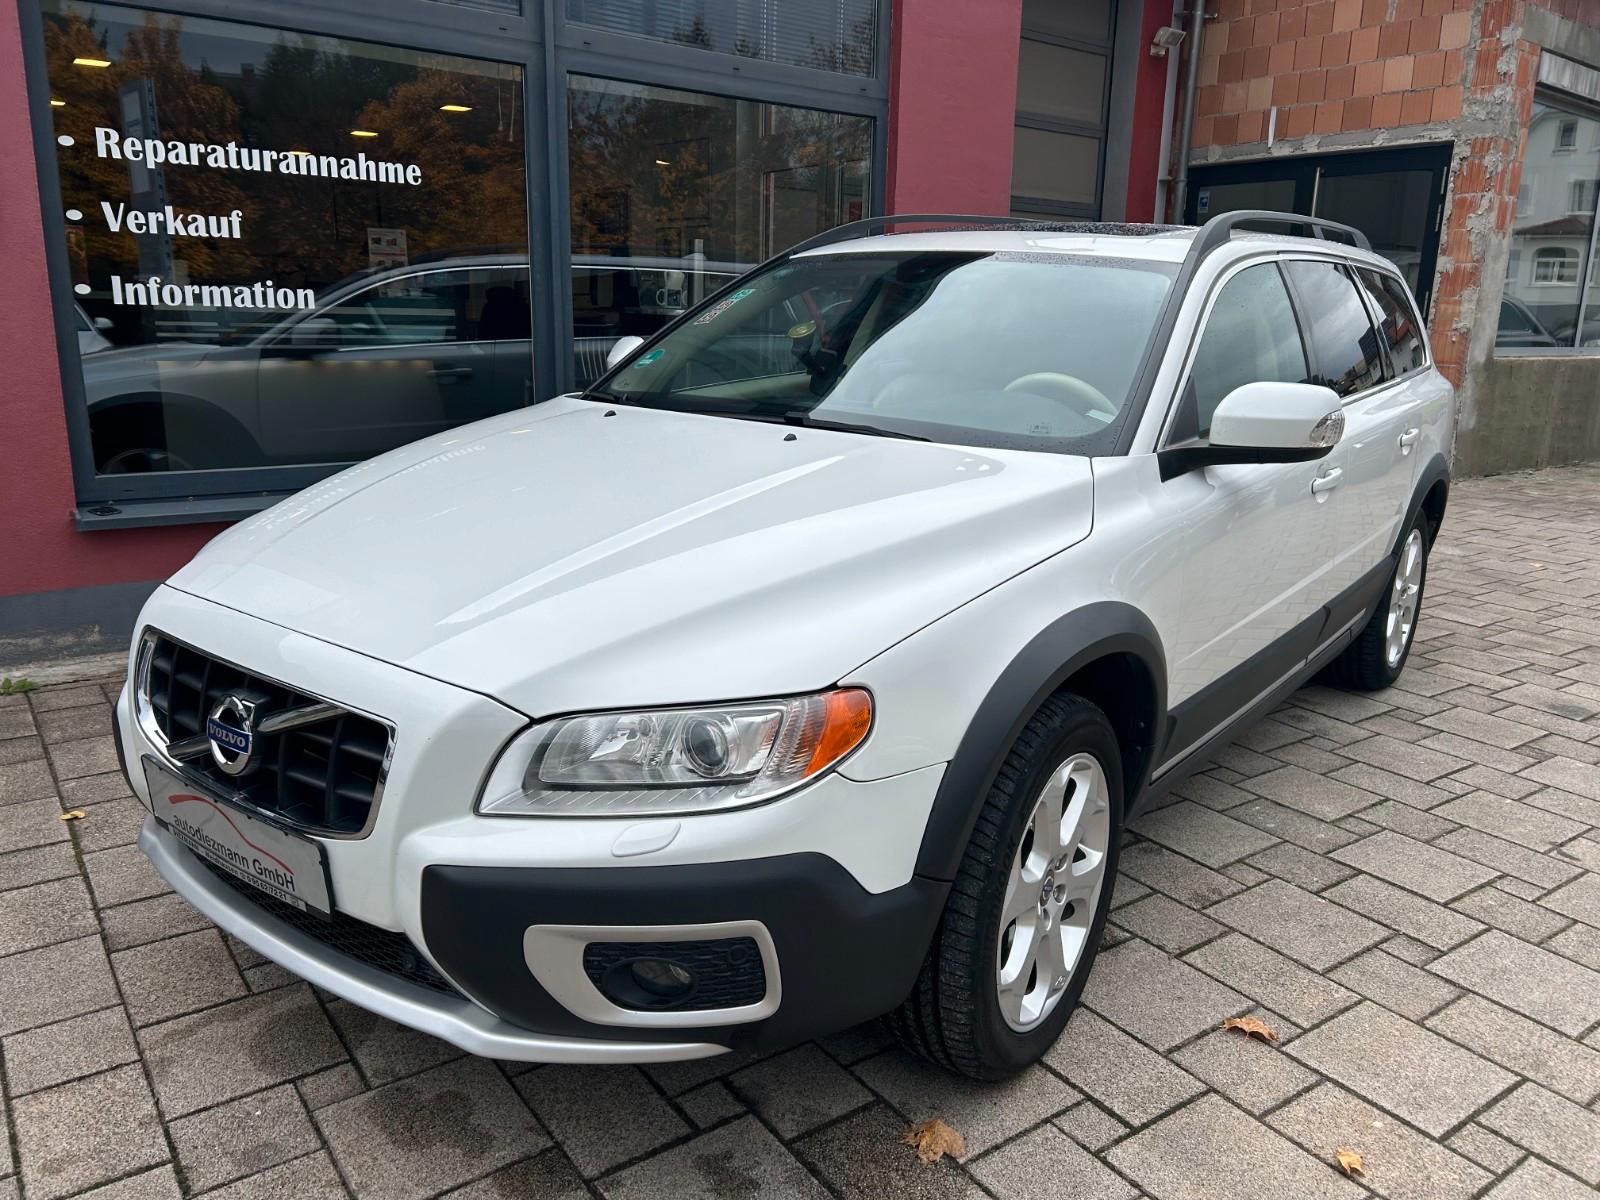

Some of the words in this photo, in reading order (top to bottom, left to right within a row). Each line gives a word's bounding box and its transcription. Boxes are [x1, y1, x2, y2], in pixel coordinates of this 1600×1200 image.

[94, 126, 423, 186] Reparaturannahme
[100, 201, 243, 239] Verkauf
[110, 275, 316, 310] Information
[209, 723, 246, 748] VOLVO
[174, 815, 250, 870] autodiezmann
[253, 858, 296, 892] GmbH
